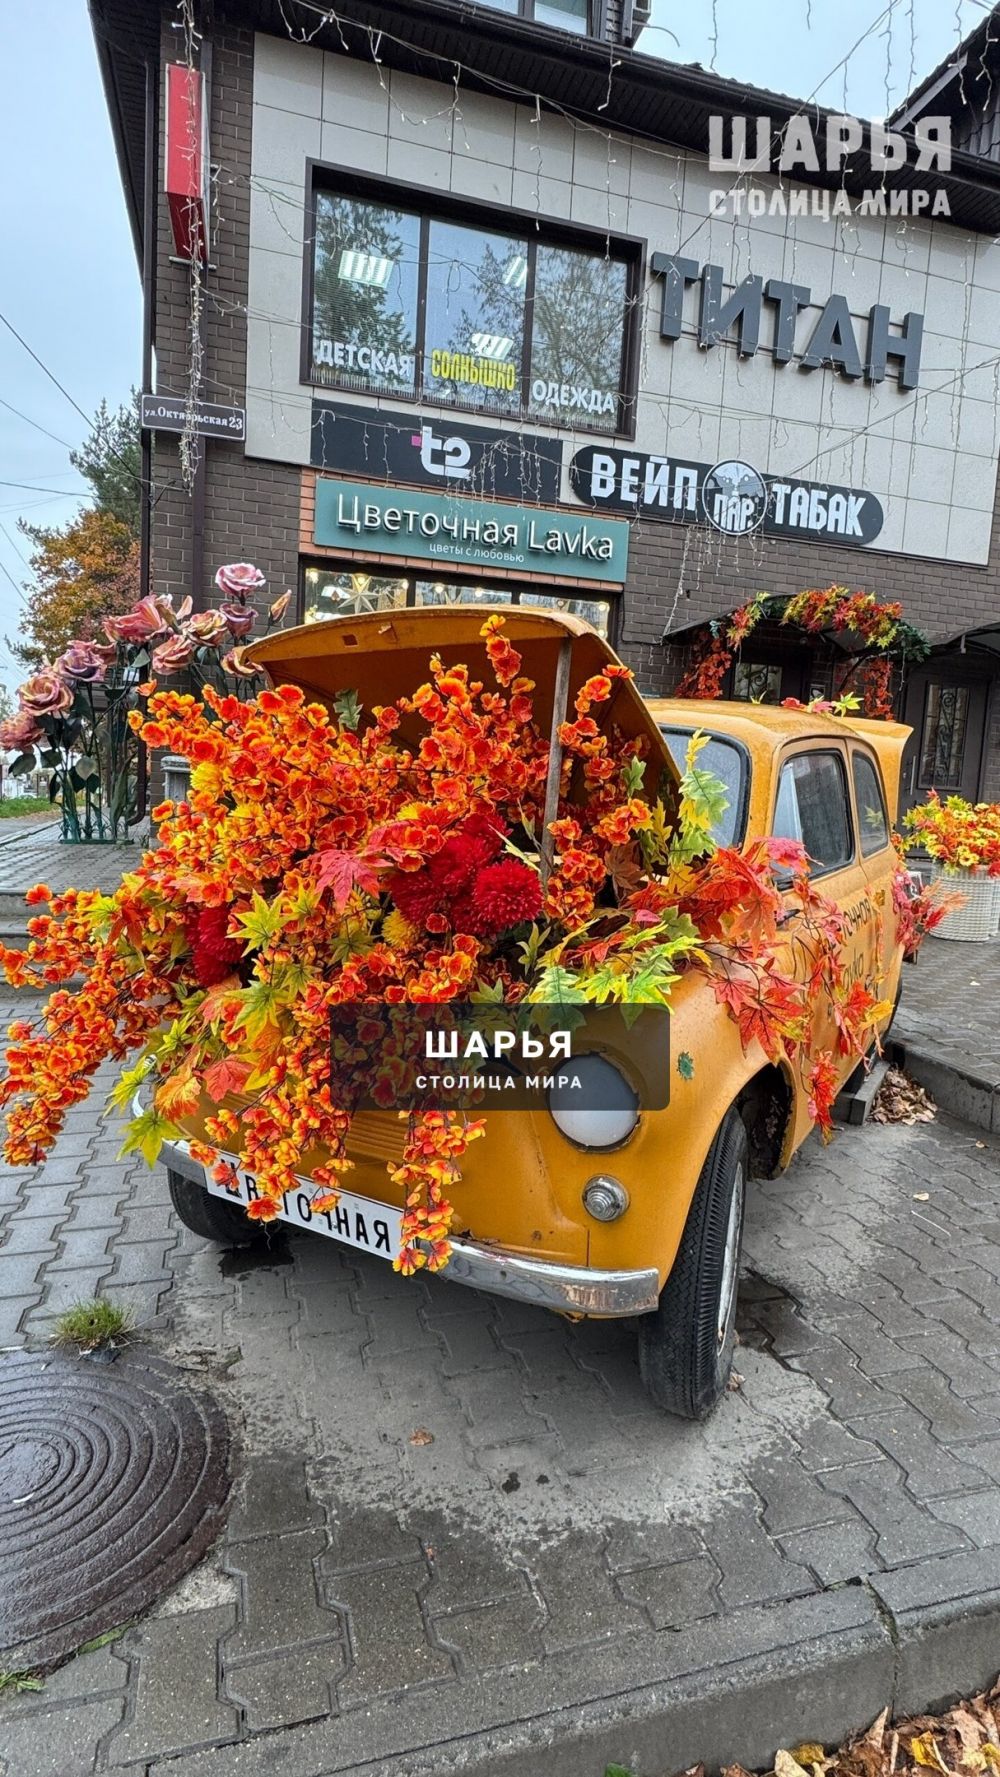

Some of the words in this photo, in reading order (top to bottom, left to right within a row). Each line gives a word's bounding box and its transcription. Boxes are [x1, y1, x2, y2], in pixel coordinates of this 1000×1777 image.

[650, 251, 924, 391] ТИТАН
[316, 340, 414, 377] ДЕТСКАЯ
[431, 348, 516, 391] СОЛНЫШКО
[532, 379, 616, 414] ОДЕЖДА
[229, 416, 243, 430] 23
[336, 492, 518, 546] Цветочная
[528, 519, 613, 560] Lavka
[591, 453, 699, 511] ВЕЙП
[771, 483, 867, 537] ТАБАК
[429, 541, 463, 556] цветы
[465, 547, 472, 555] с
[474, 547, 525, 563] любовью
[220, 1157, 392, 1253] ВТОЧНАЯ
